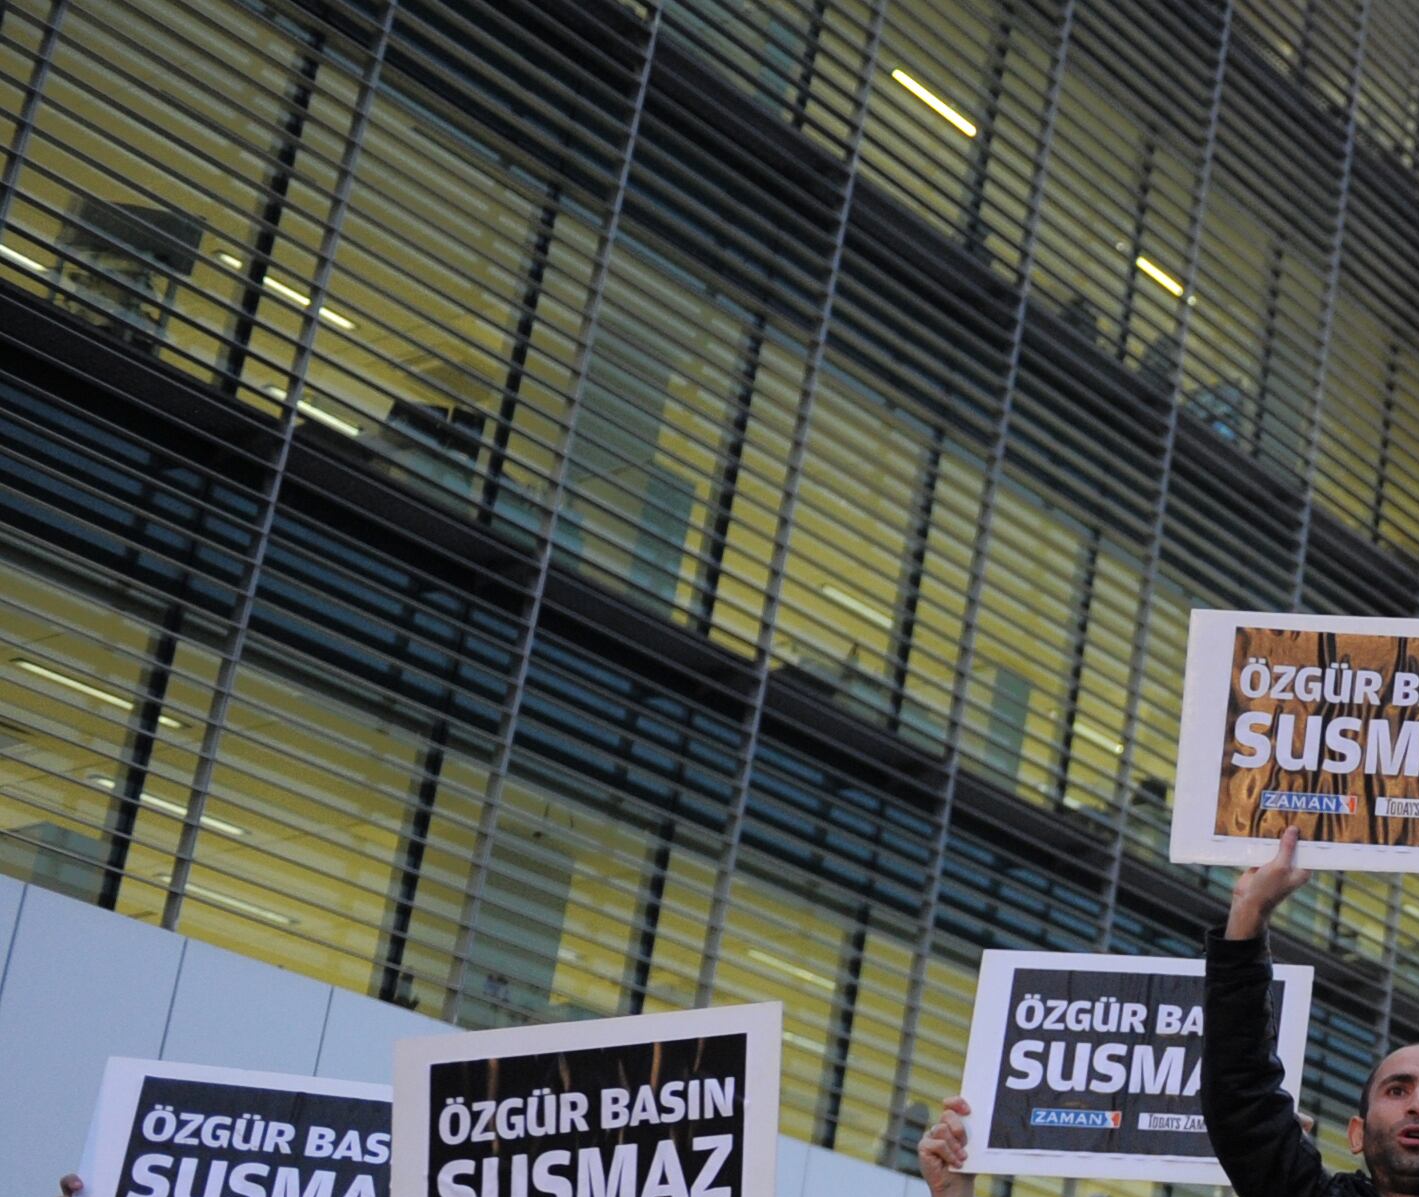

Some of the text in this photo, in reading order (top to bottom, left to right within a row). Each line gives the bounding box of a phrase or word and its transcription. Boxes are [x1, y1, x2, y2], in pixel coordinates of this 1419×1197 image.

[1239, 657, 1381, 705] ÖZGÜR
[1264, 792, 1338, 811] ZAMAN
[1015, 993, 1147, 1034] ÖZGÜR
[1006, 1039, 1202, 1096] SUSM
[142, 1105, 391, 1164] ÖZGÜR BAS
[438, 1076, 736, 1145] ÖZGÜR BASIN
[1035, 1111, 1102, 1125] ZAMAN
